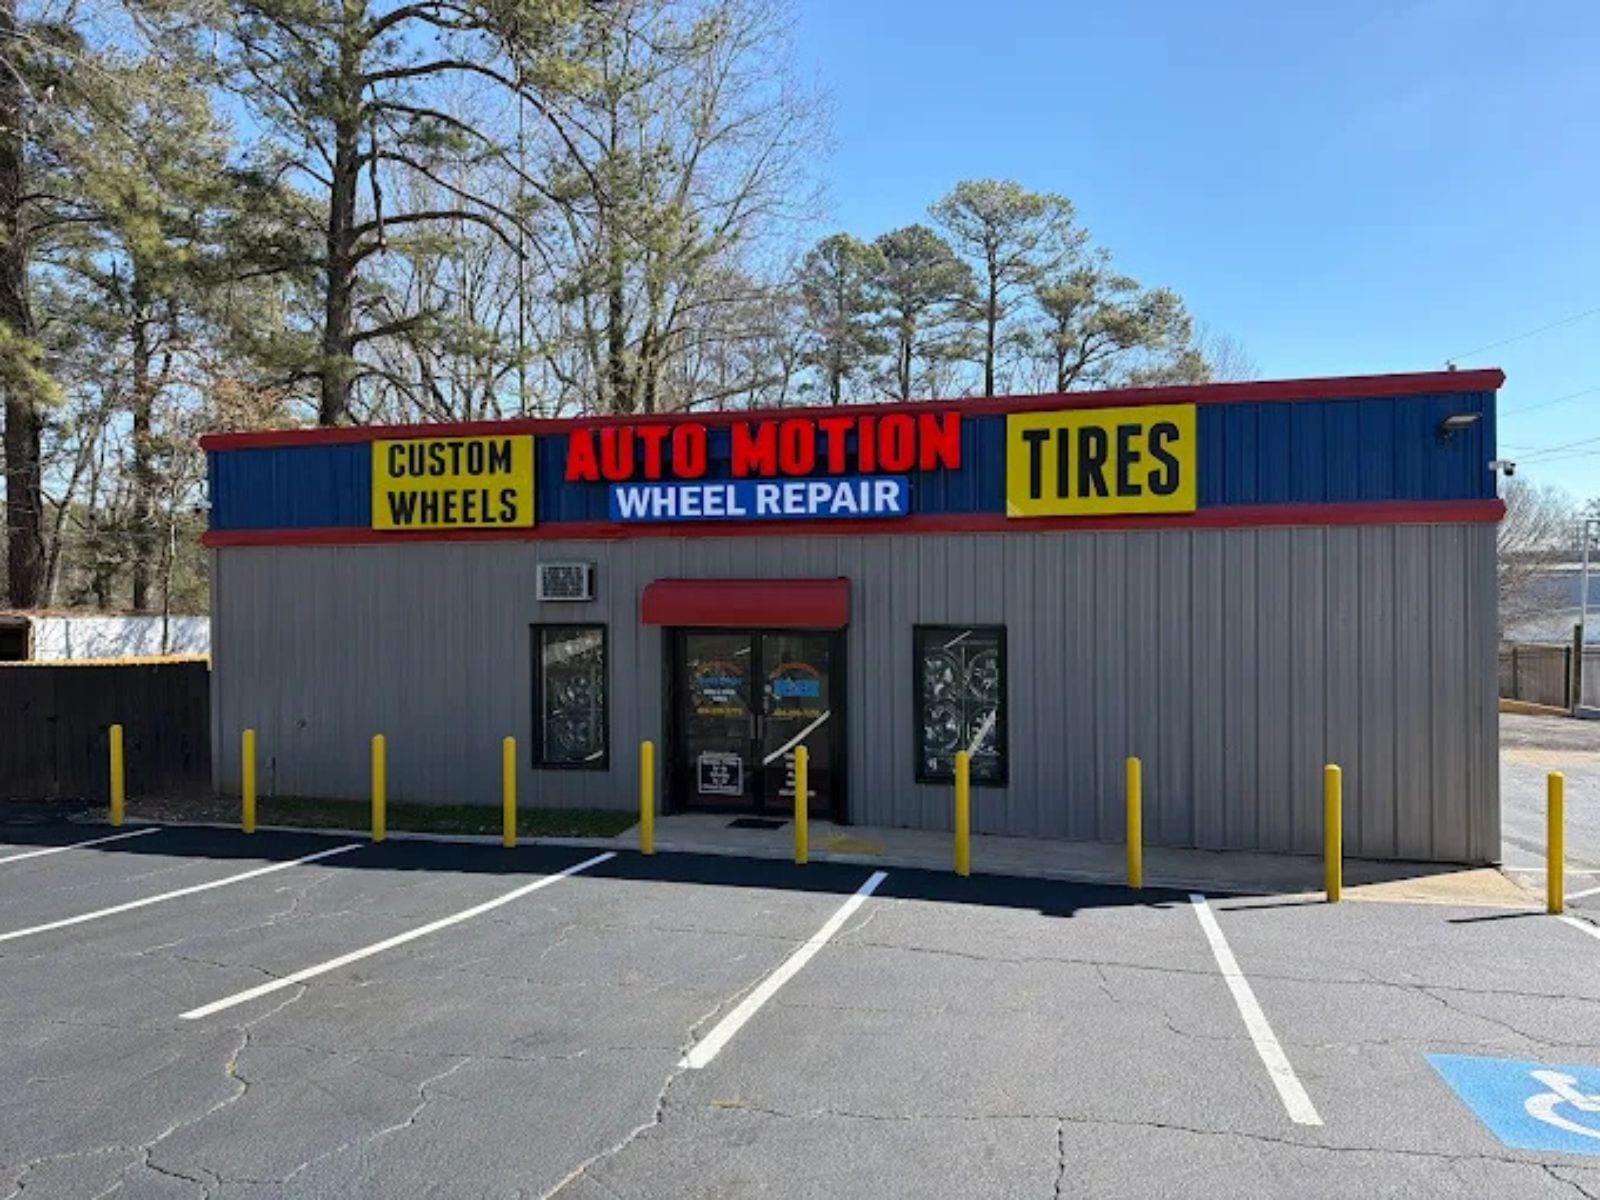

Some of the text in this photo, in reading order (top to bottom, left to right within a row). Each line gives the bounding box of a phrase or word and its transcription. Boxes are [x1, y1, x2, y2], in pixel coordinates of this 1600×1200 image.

[388, 439, 512, 478] CUSTOM
[564, 411, 961, 482] AUTO MOTION
[1022, 422, 1180, 499] TIRES
[387, 488, 518, 525] WHEELS
[615, 479, 901, 518] WHEEL REPAIR
